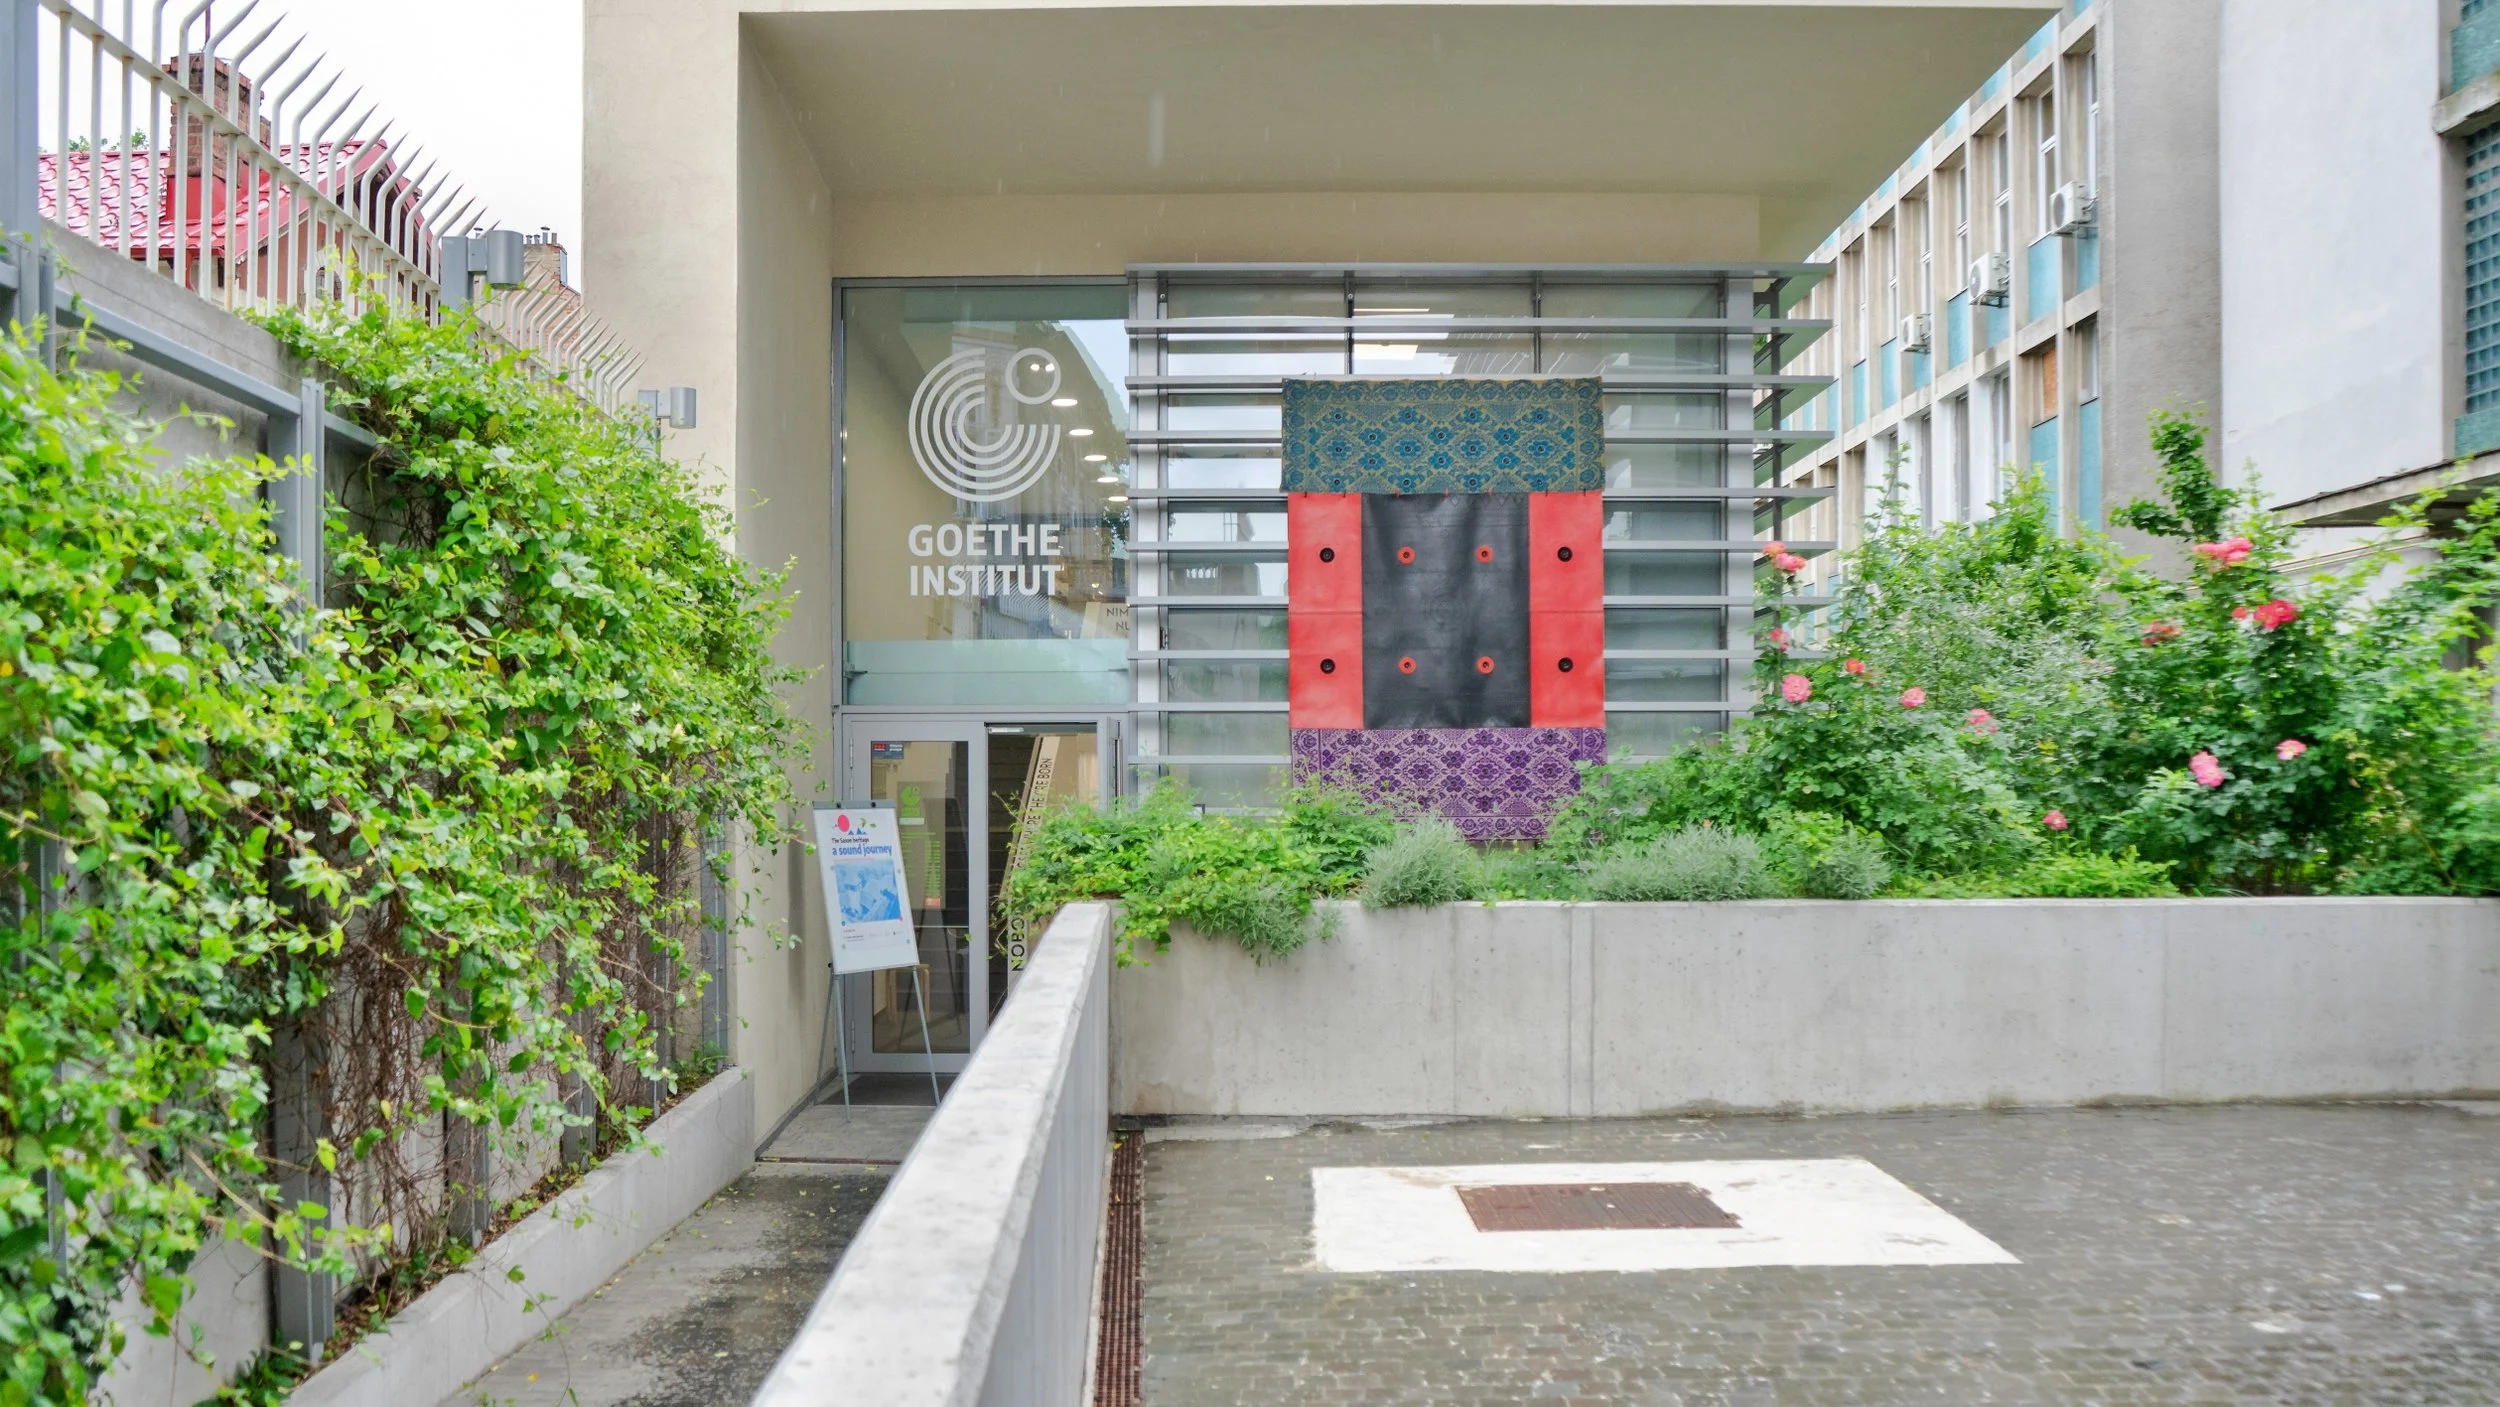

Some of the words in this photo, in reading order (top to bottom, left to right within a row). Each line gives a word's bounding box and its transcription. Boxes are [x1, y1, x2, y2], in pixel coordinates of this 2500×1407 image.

[908, 524, 1061, 557] GOETHE
[910, 565, 1061, 596] INSTITUT
[1037, 757, 1053, 780] BORN
[832, 847, 838, 856] a
[839, 844, 862, 856] sound
[863, 844, 892, 857] journey
